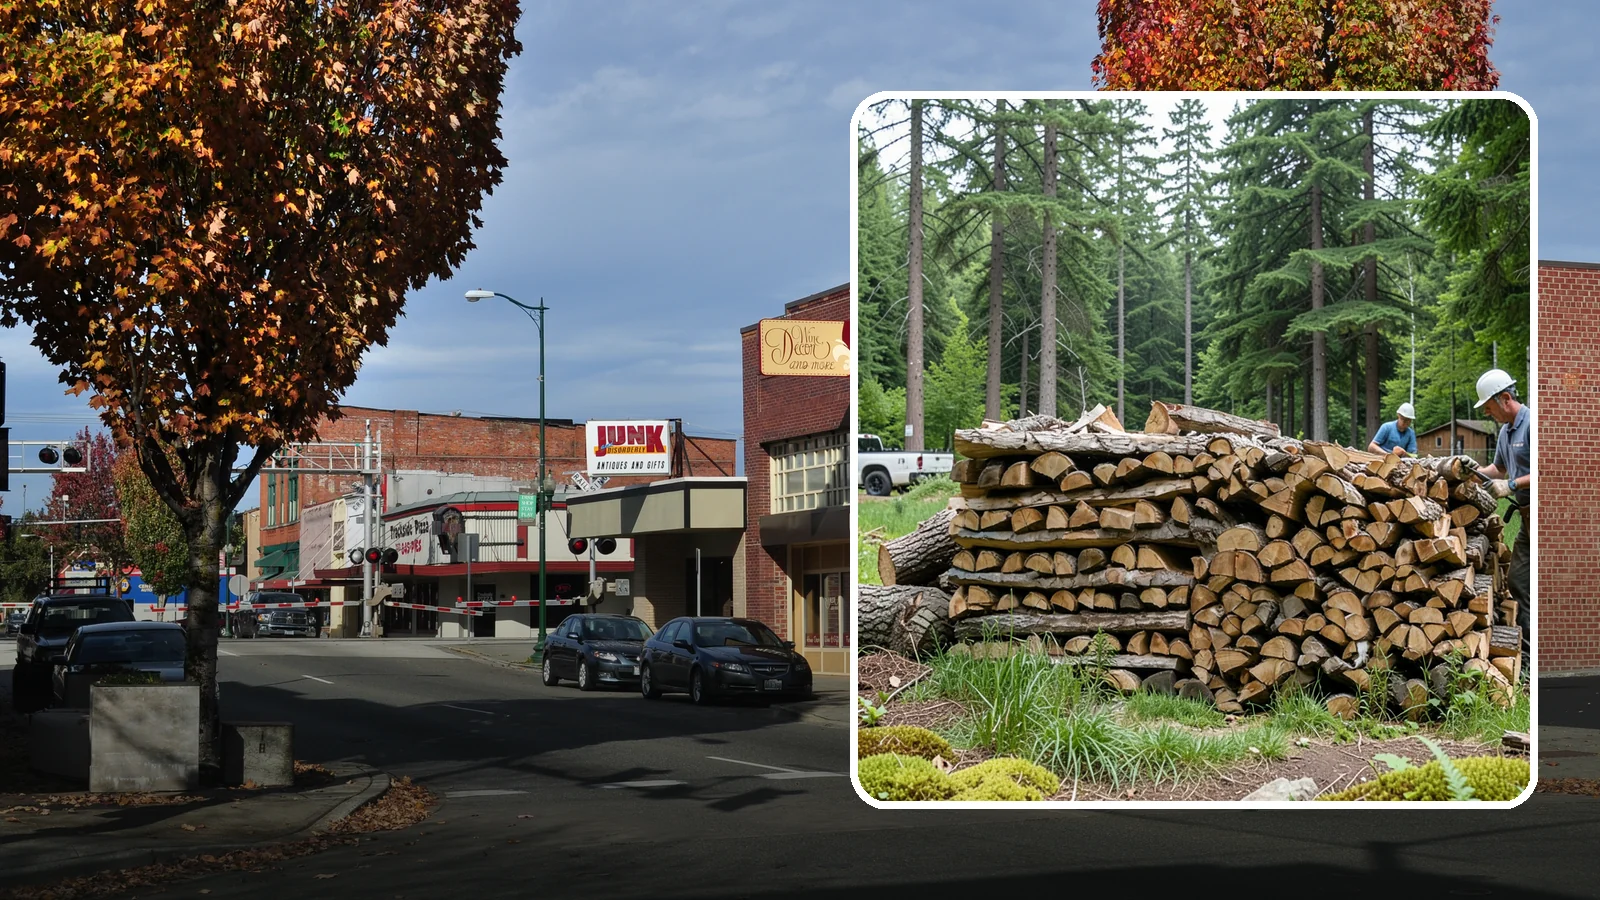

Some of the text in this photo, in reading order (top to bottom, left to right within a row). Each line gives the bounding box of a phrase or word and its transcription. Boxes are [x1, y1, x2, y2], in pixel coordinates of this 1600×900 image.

[596, 425, 664, 457] JUNK
[597, 460, 665, 470] ANTIQUES AND GIFTS
[414, 519, 429, 535] Pizza
